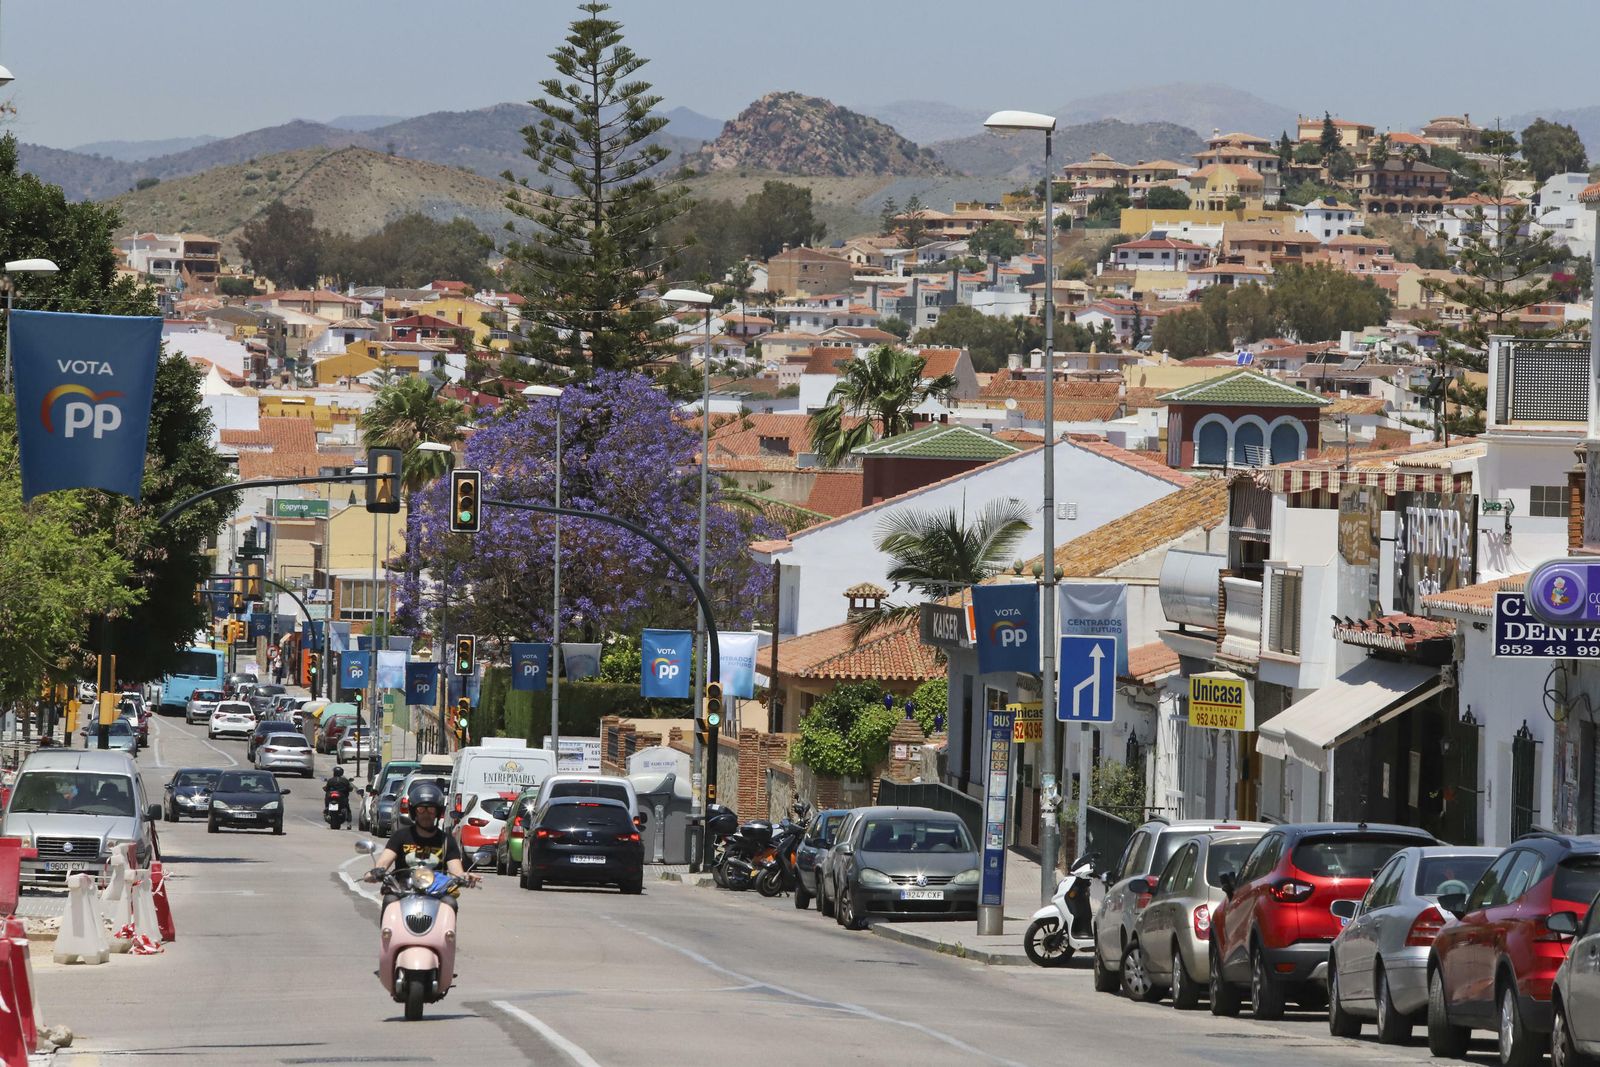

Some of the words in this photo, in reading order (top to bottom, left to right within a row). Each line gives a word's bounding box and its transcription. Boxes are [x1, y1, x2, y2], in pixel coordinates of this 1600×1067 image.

[57, 359, 114, 376] VOTA
[995, 608, 1022, 617] VOTA
[933, 612, 958, 641] KAISER
[1067, 619, 1122, 627] CENTRADOS
[1504, 623, 1600, 642] DENTA
[1500, 645, 1533, 655] 952
[1543, 645, 1567, 656] 43
[1576, 646, 1600, 656] 99
[1193, 678, 1242, 704] Unicasa
[993, 715, 1010, 727] BUS
[1197, 713, 1208, 725] 952
[1210, 714, 1218, 726] 43
[1220, 714, 1228, 727] 96
[1230, 716, 1238, 727] 47
[1025, 722, 1034, 739] 43
[993, 761, 1005, 769] 62
[484, 772, 536, 784] ENTREPINARES
[50, 862, 69, 870] 9600
